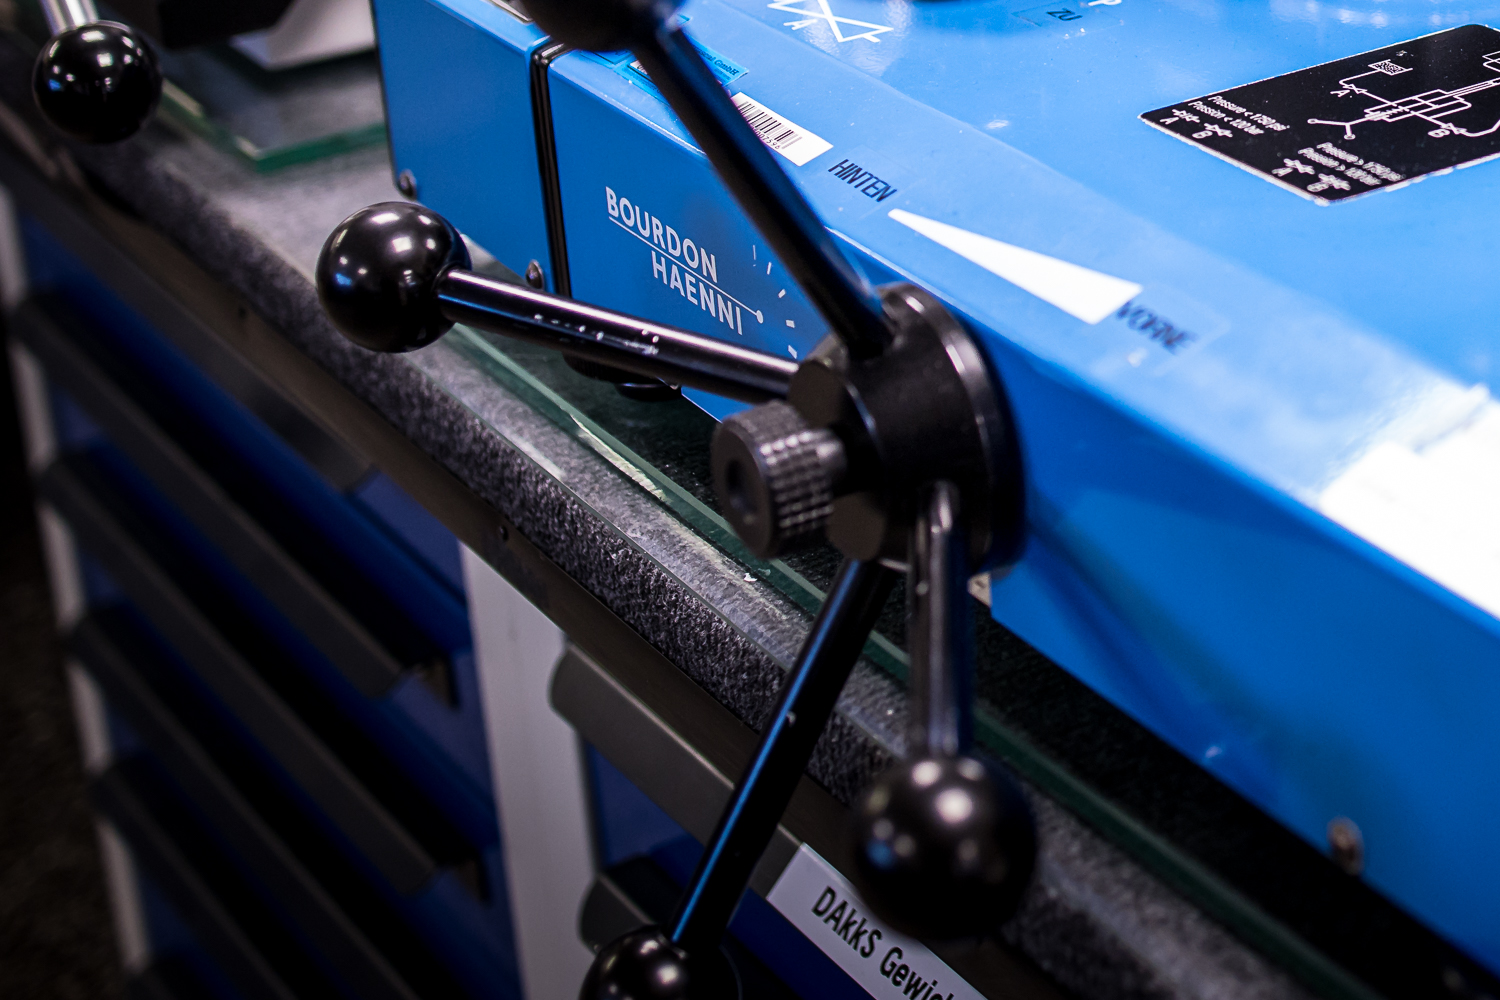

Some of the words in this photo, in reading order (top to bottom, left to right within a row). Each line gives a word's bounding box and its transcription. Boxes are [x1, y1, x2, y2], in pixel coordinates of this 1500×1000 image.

[1046, 8, 1083, 21] ZU
[783, 18, 818, 30] A
[714, 59, 740, 76] GmbH
[1330, 89, 1351, 98] A
[1188, 101, 1226, 119] Pression
[1207, 95, 1247, 114] Pressure
[1160, 116, 1179, 125] A
[827, 158, 898, 203] HINTEN
[605, 186, 718, 284] BOURDON
[651, 250, 743, 336] HAENNI
[811, 885, 882, 959] DAkkS
[880, 946, 955, 1000] Gewi
